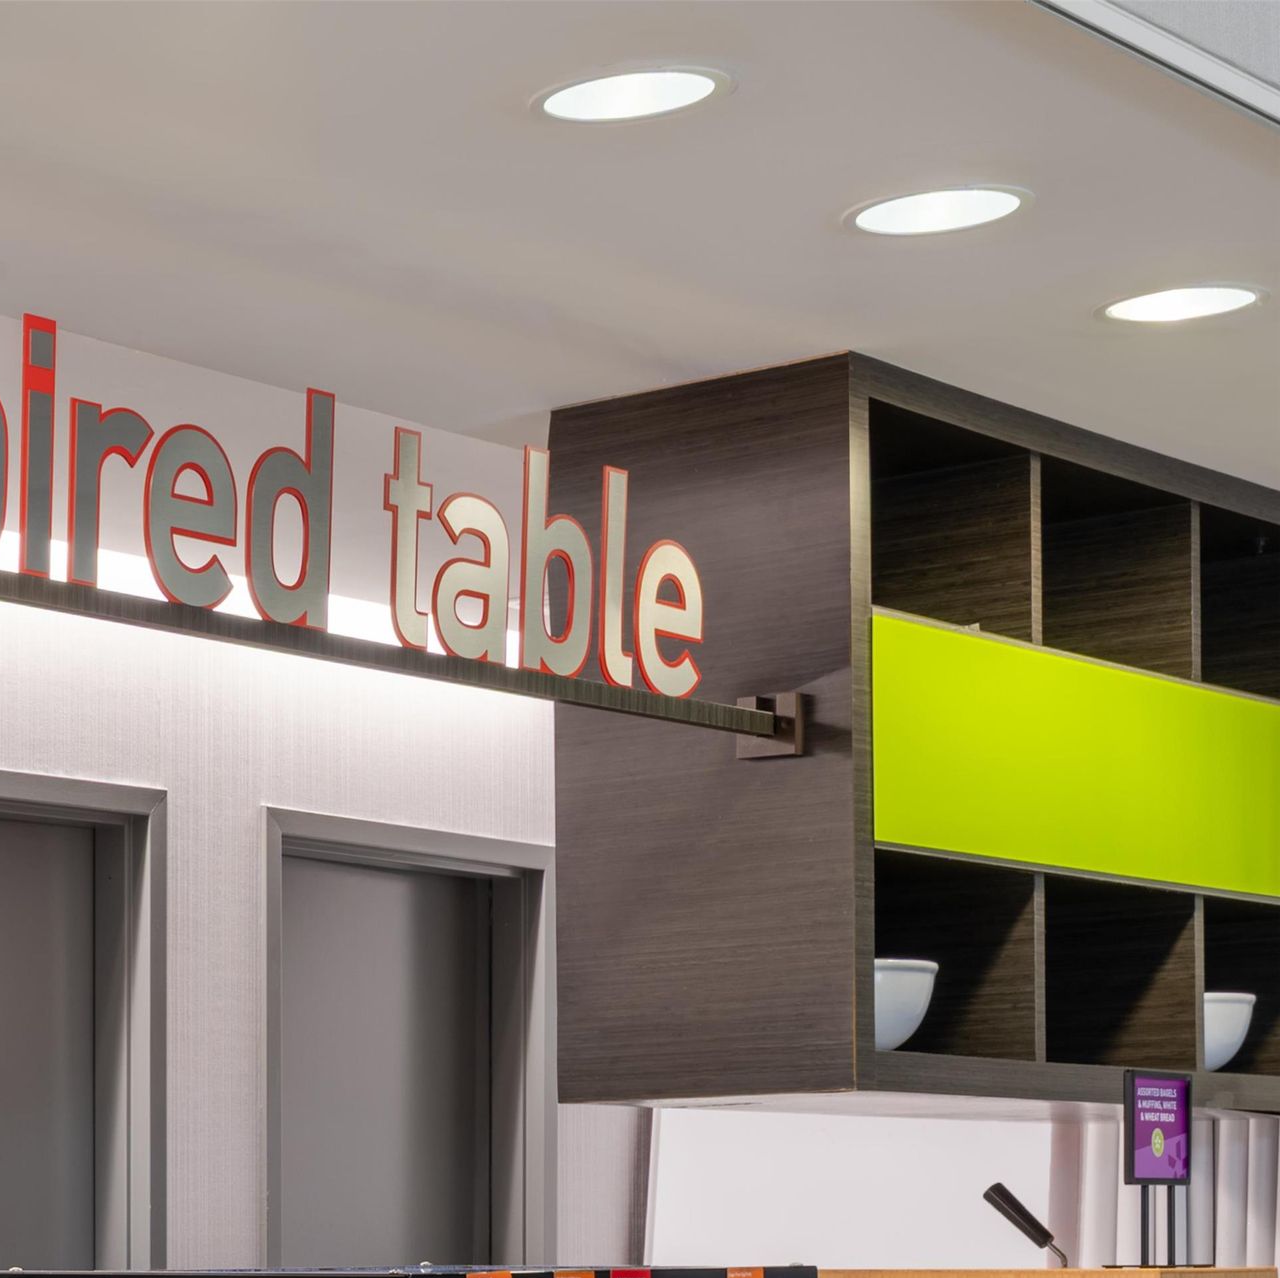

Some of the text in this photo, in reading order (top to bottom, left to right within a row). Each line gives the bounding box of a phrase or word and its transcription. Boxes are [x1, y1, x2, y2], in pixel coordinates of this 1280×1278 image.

[384, 426, 704, 698] table
[1137, 1087, 1177, 1097] ASSORTED BAGELS
[1145, 1112, 1159, 1121] WHEAT
[1160, 1113, 1175, 1122] BREAD
